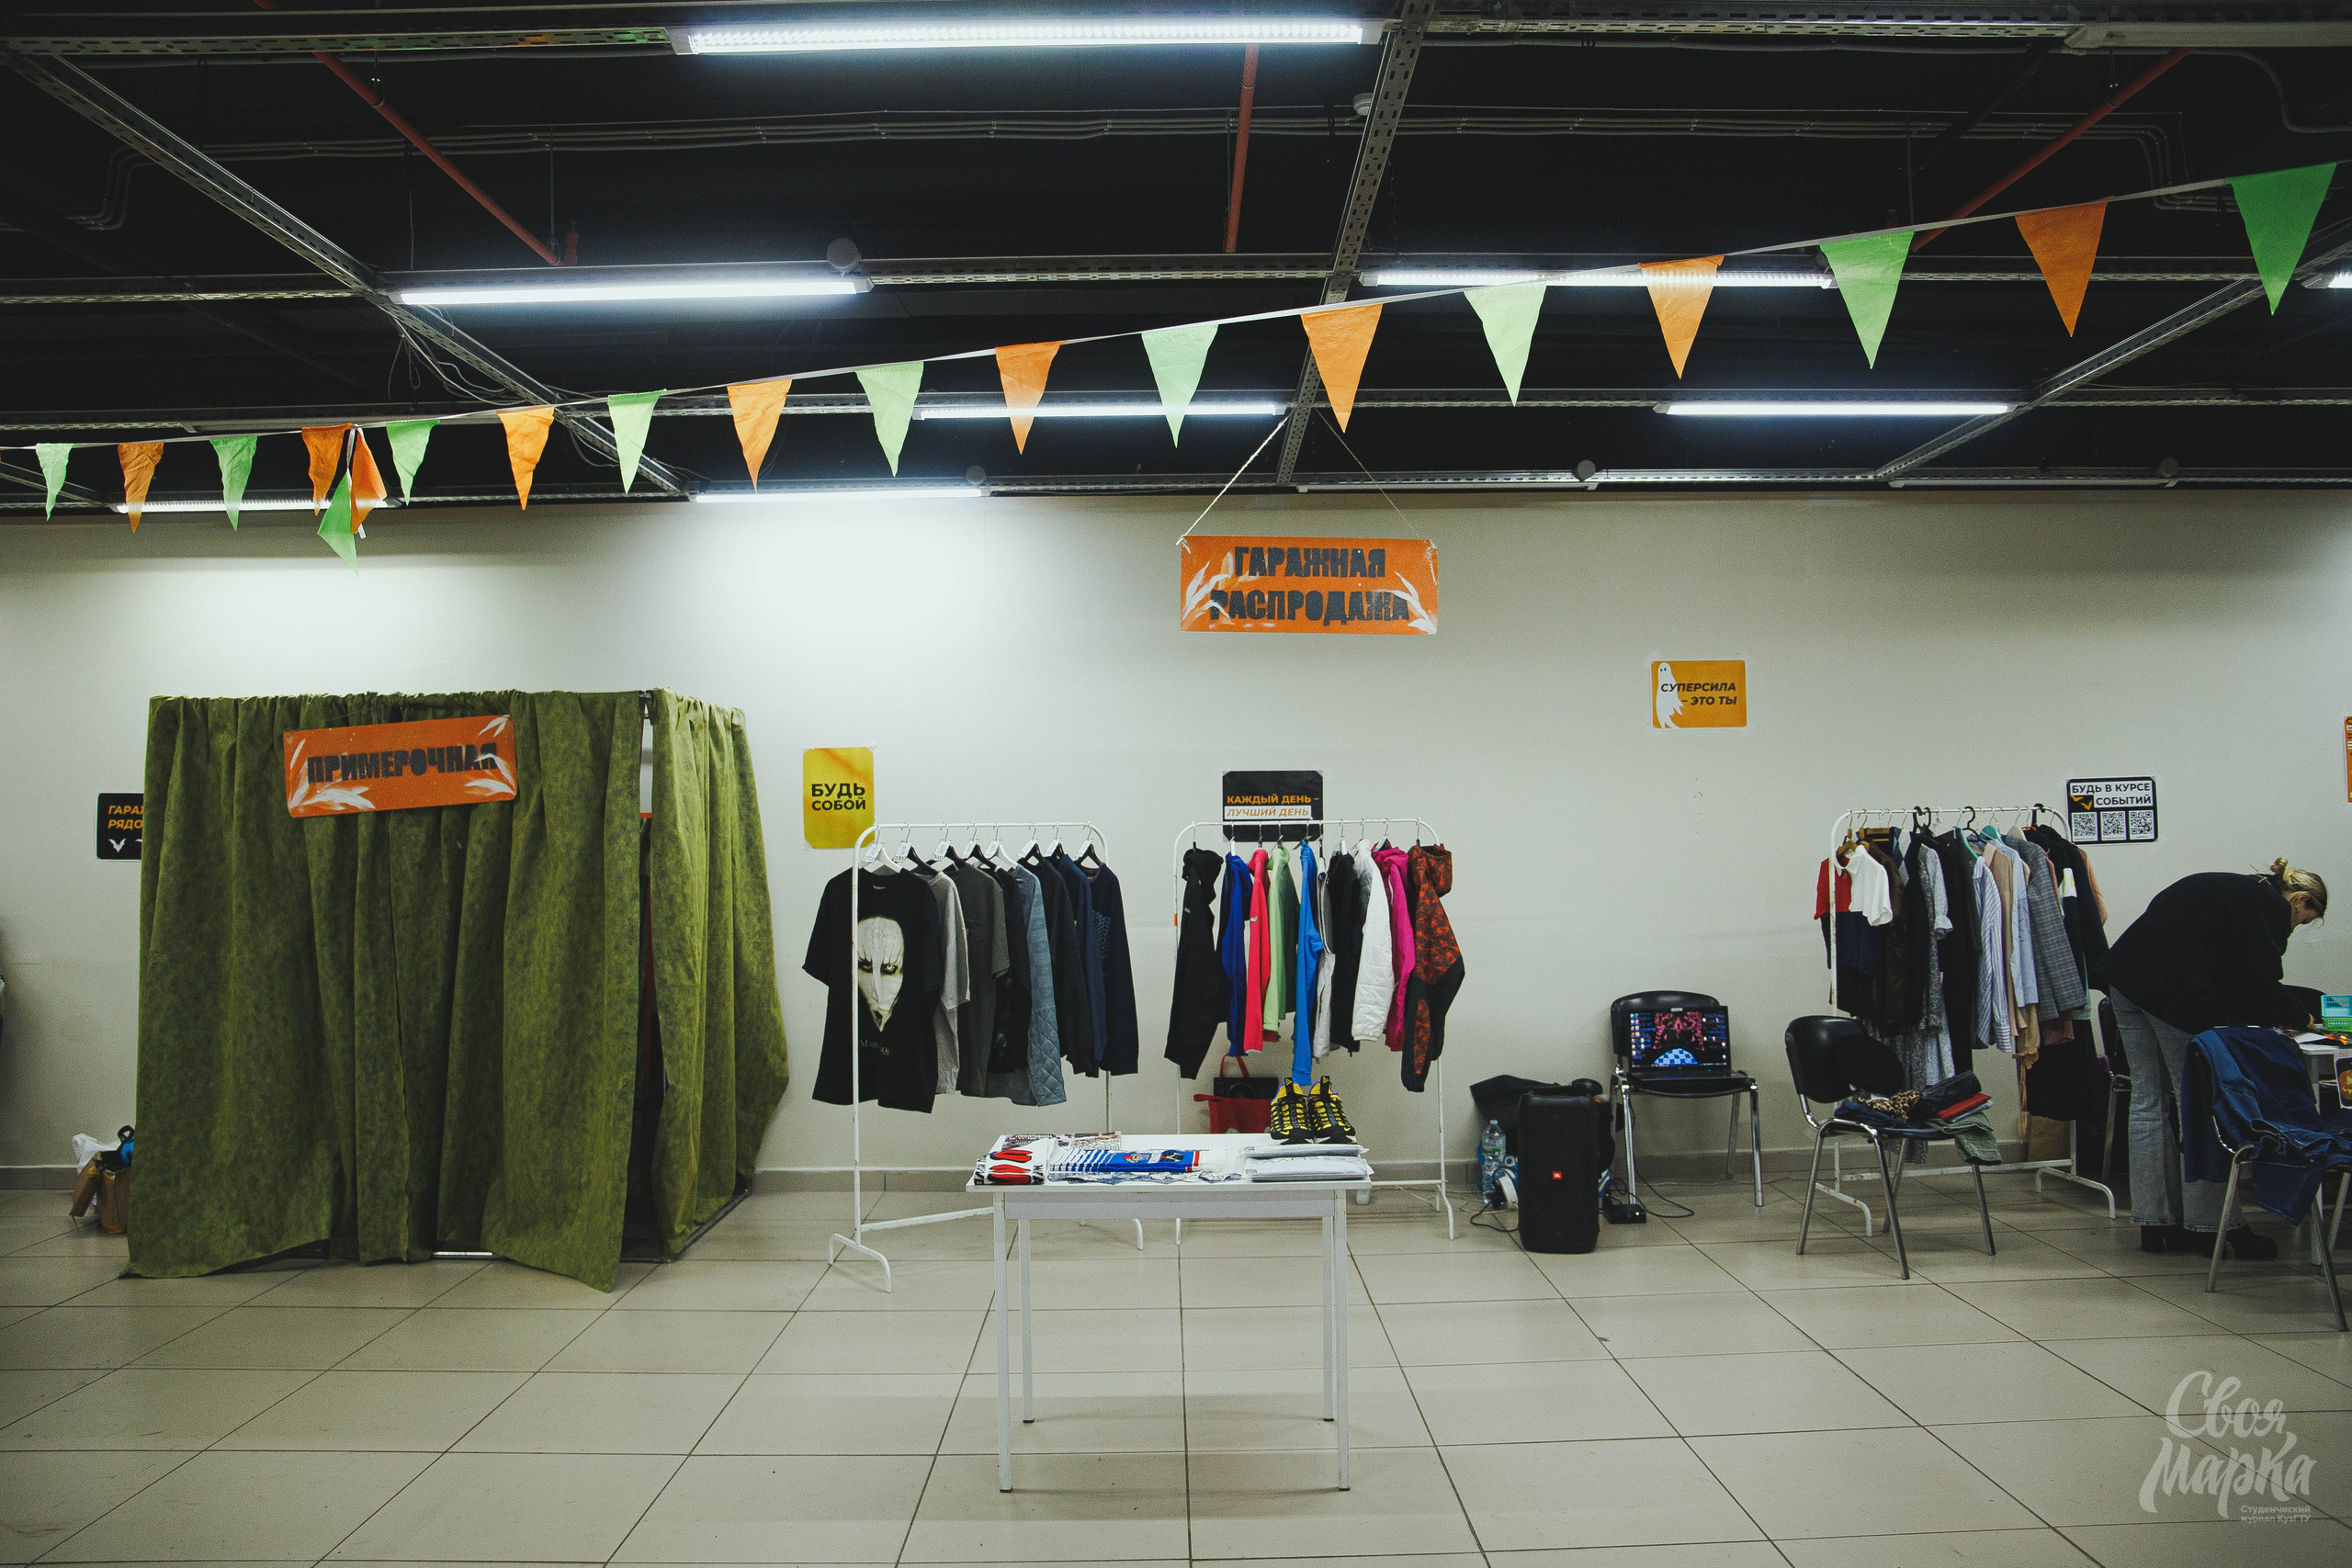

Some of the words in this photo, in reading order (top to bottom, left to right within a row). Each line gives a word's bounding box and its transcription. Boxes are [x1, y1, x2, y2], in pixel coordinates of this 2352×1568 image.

[1234, 546, 1386, 578] ГАРАЖНАЯ
[1209, 589, 1410, 626] РАСПРОДАЖА
[1660, 682, 1736, 693] СУПЕРСИЛА
[1690, 696, 1715, 705] ЭТО
[1718, 696, 1737, 705] ТЫ
[307, 742, 499, 784] ПРИМЕРОЧНАЯ
[811, 783, 865, 798] БУДЬ
[2072, 784, 2102, 794] БУДЬ
[2105, 784, 2112, 792] В
[2115, 783, 2151, 792] КУРСЕ
[811, 797, 866, 811] СОБОЙ
[1227, 794, 1279, 805] КАЖДЫЙ
[1281, 795, 1312, 805] ДЕНЬ
[2096, 794, 2152, 806] СОБЫТИЙ
[1227, 807, 1277, 817] ЛУЧШИЙ
[1278, 808, 1309, 818] ДЕНЬ
